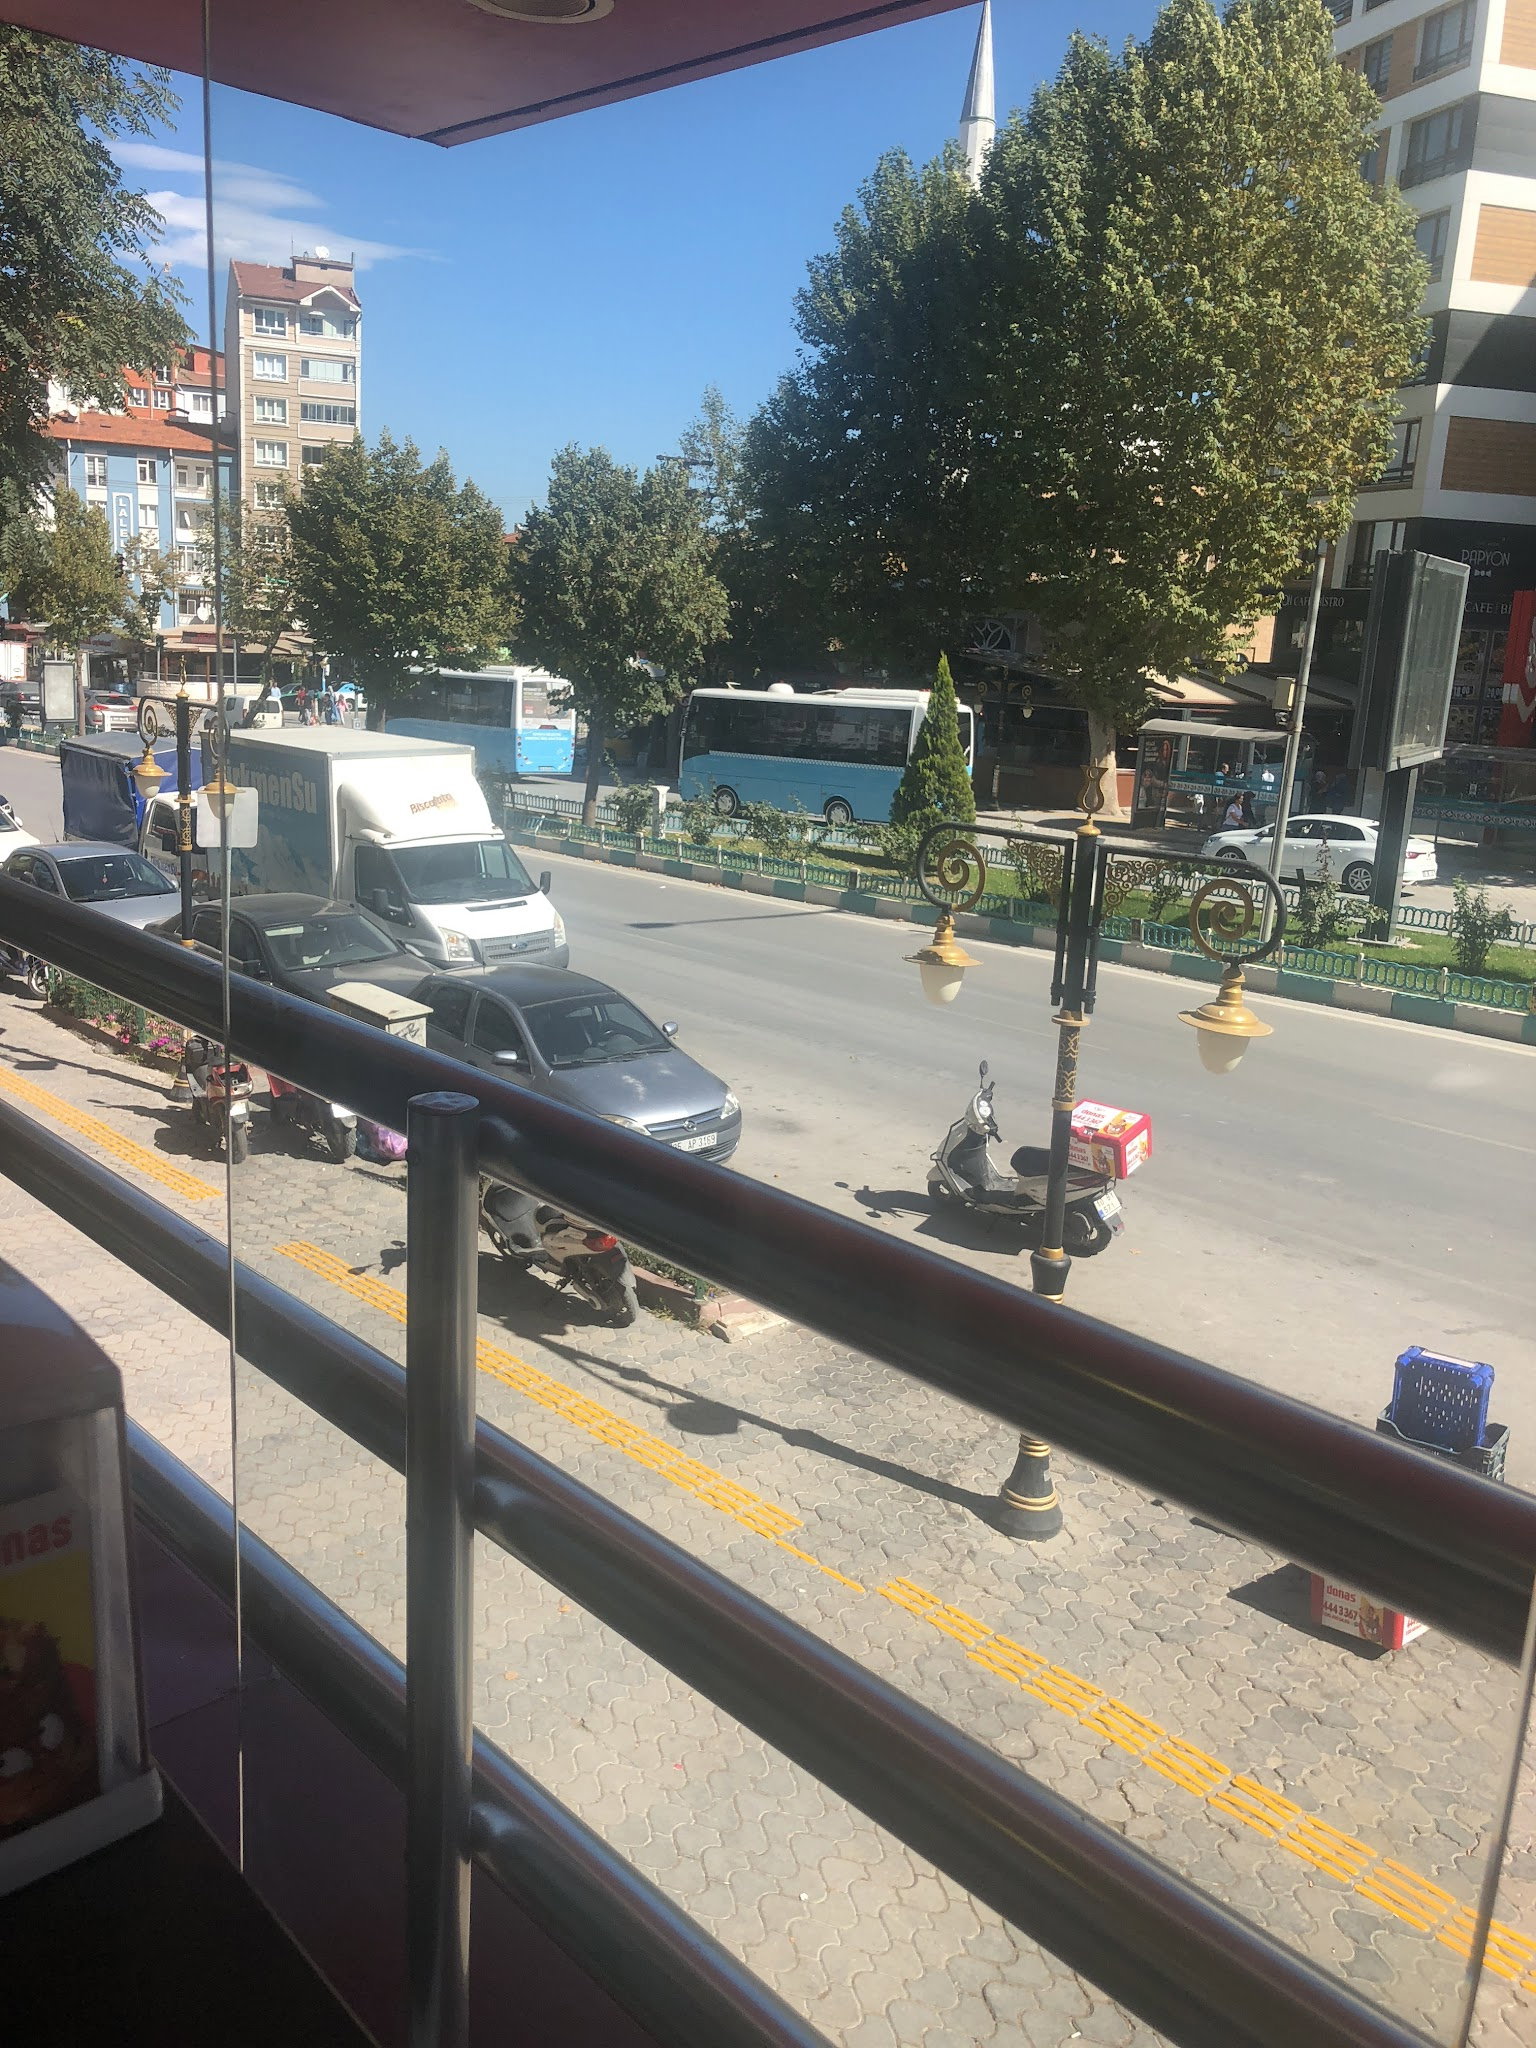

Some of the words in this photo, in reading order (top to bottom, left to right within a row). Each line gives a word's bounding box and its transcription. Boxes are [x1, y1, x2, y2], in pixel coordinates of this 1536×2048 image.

[1461, 549, 1511, 566] PAPYON
[1464, 601, 1493, 613] CAFE
[1326, 1584, 1357, 1603] donas
